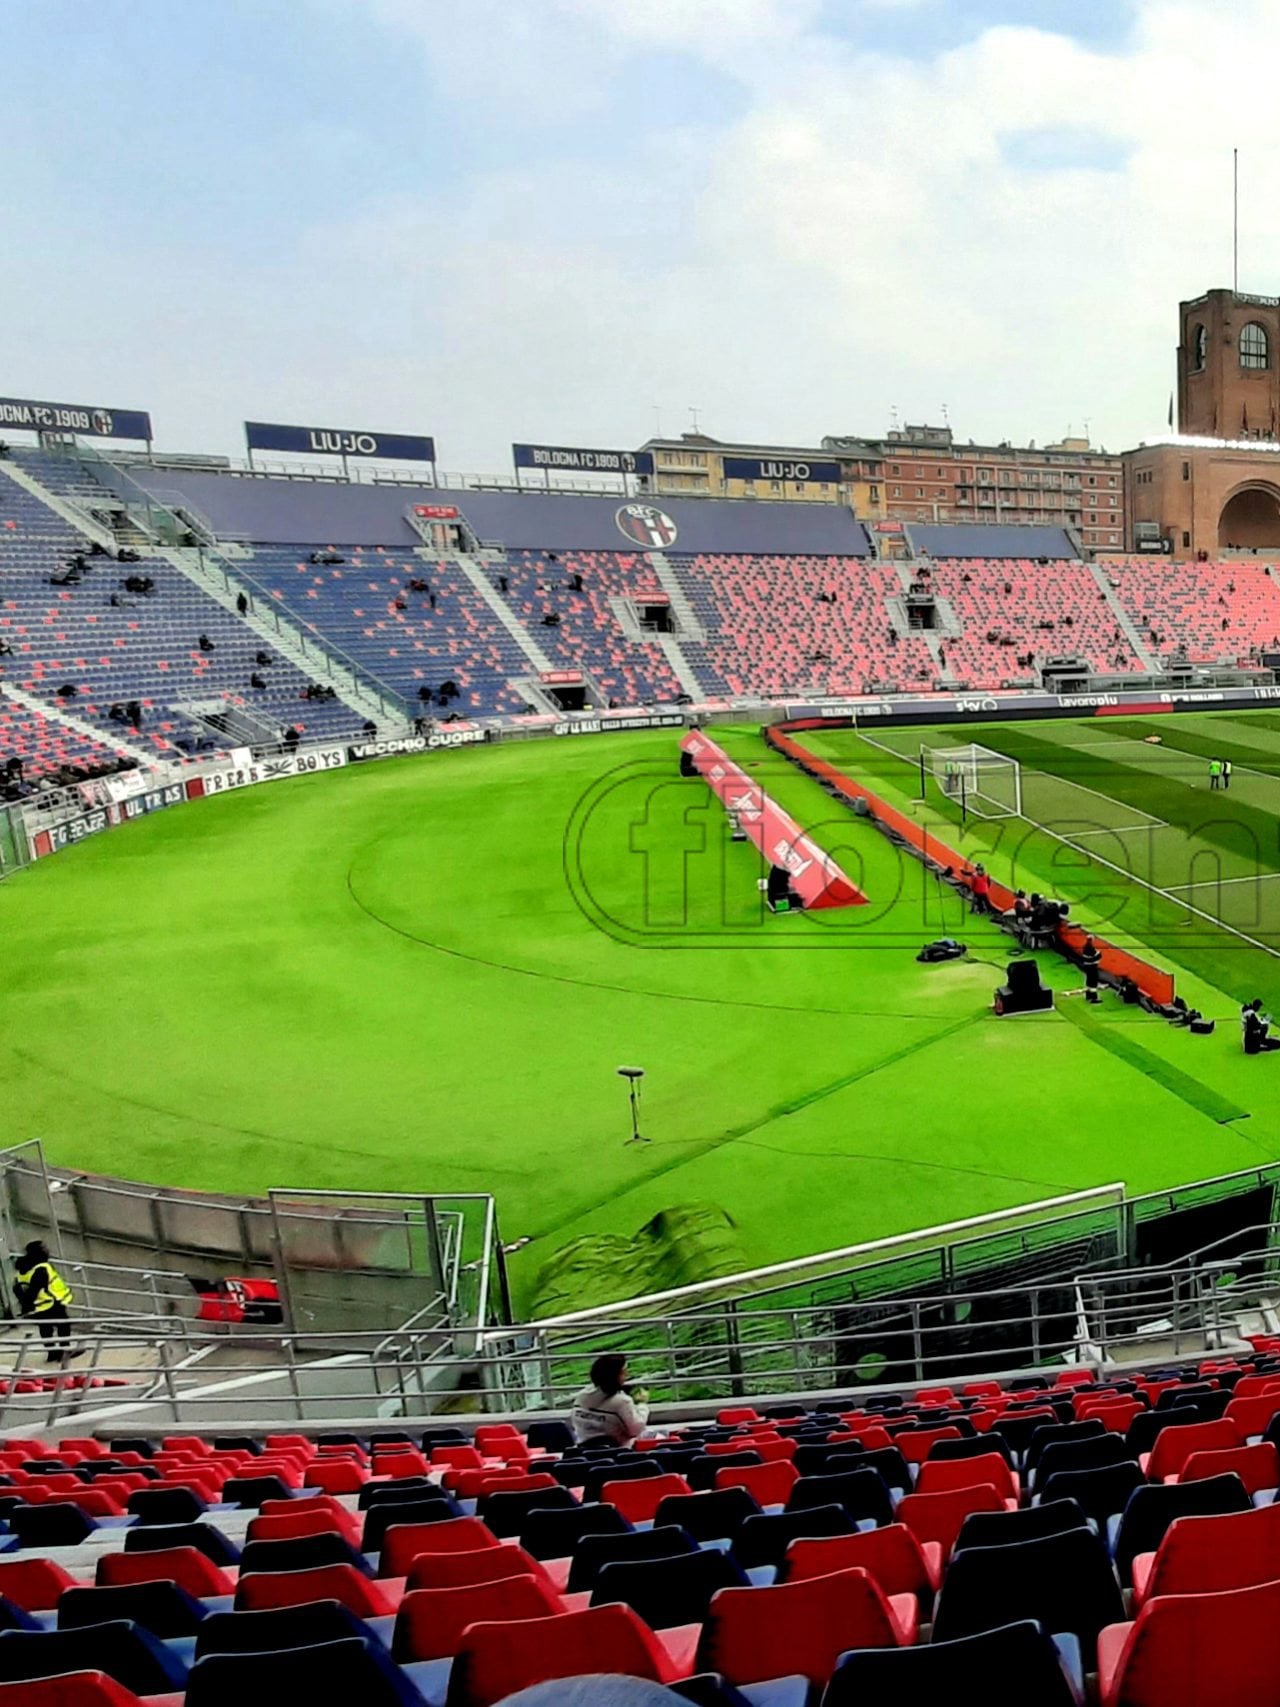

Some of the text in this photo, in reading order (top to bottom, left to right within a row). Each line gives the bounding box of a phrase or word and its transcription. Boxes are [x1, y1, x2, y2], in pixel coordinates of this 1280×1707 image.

[0, 404, 90, 429] GNA FC 1909
[533, 450, 620, 469] BOLOGNA FC 1909
[353, 730, 486, 757] VECCHIO CUORE
[296, 751, 342, 772] BOYS
